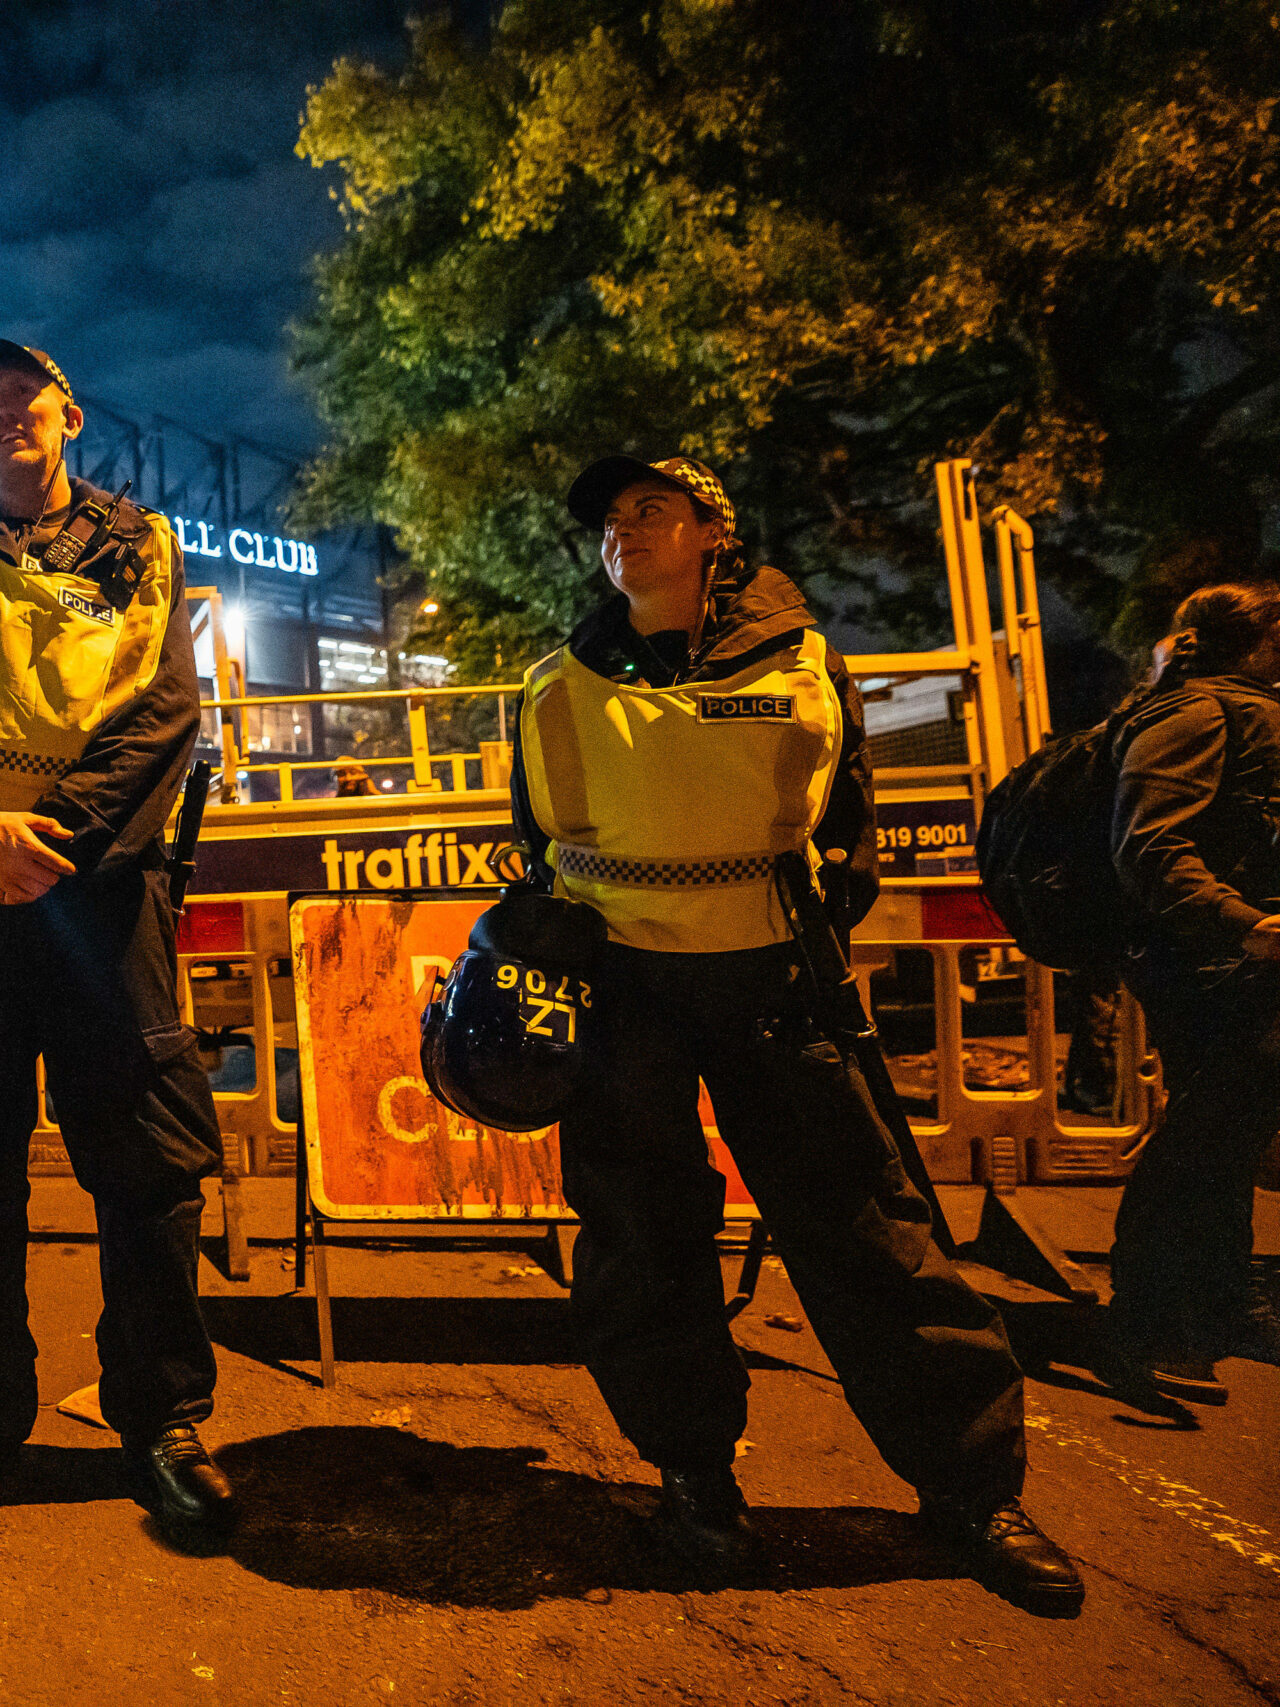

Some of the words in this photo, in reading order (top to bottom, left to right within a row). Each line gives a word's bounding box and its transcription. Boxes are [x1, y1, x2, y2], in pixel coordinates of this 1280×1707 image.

[229, 528, 320, 576] CLUB
[64, 593, 112, 621] POLIE
[706, 698, 789, 715] POLICE
[916, 823, 967, 846] 9001
[321, 832, 501, 890] traffix
[496, 964, 593, 1009] 2706
[525, 997, 576, 1044] LZ
